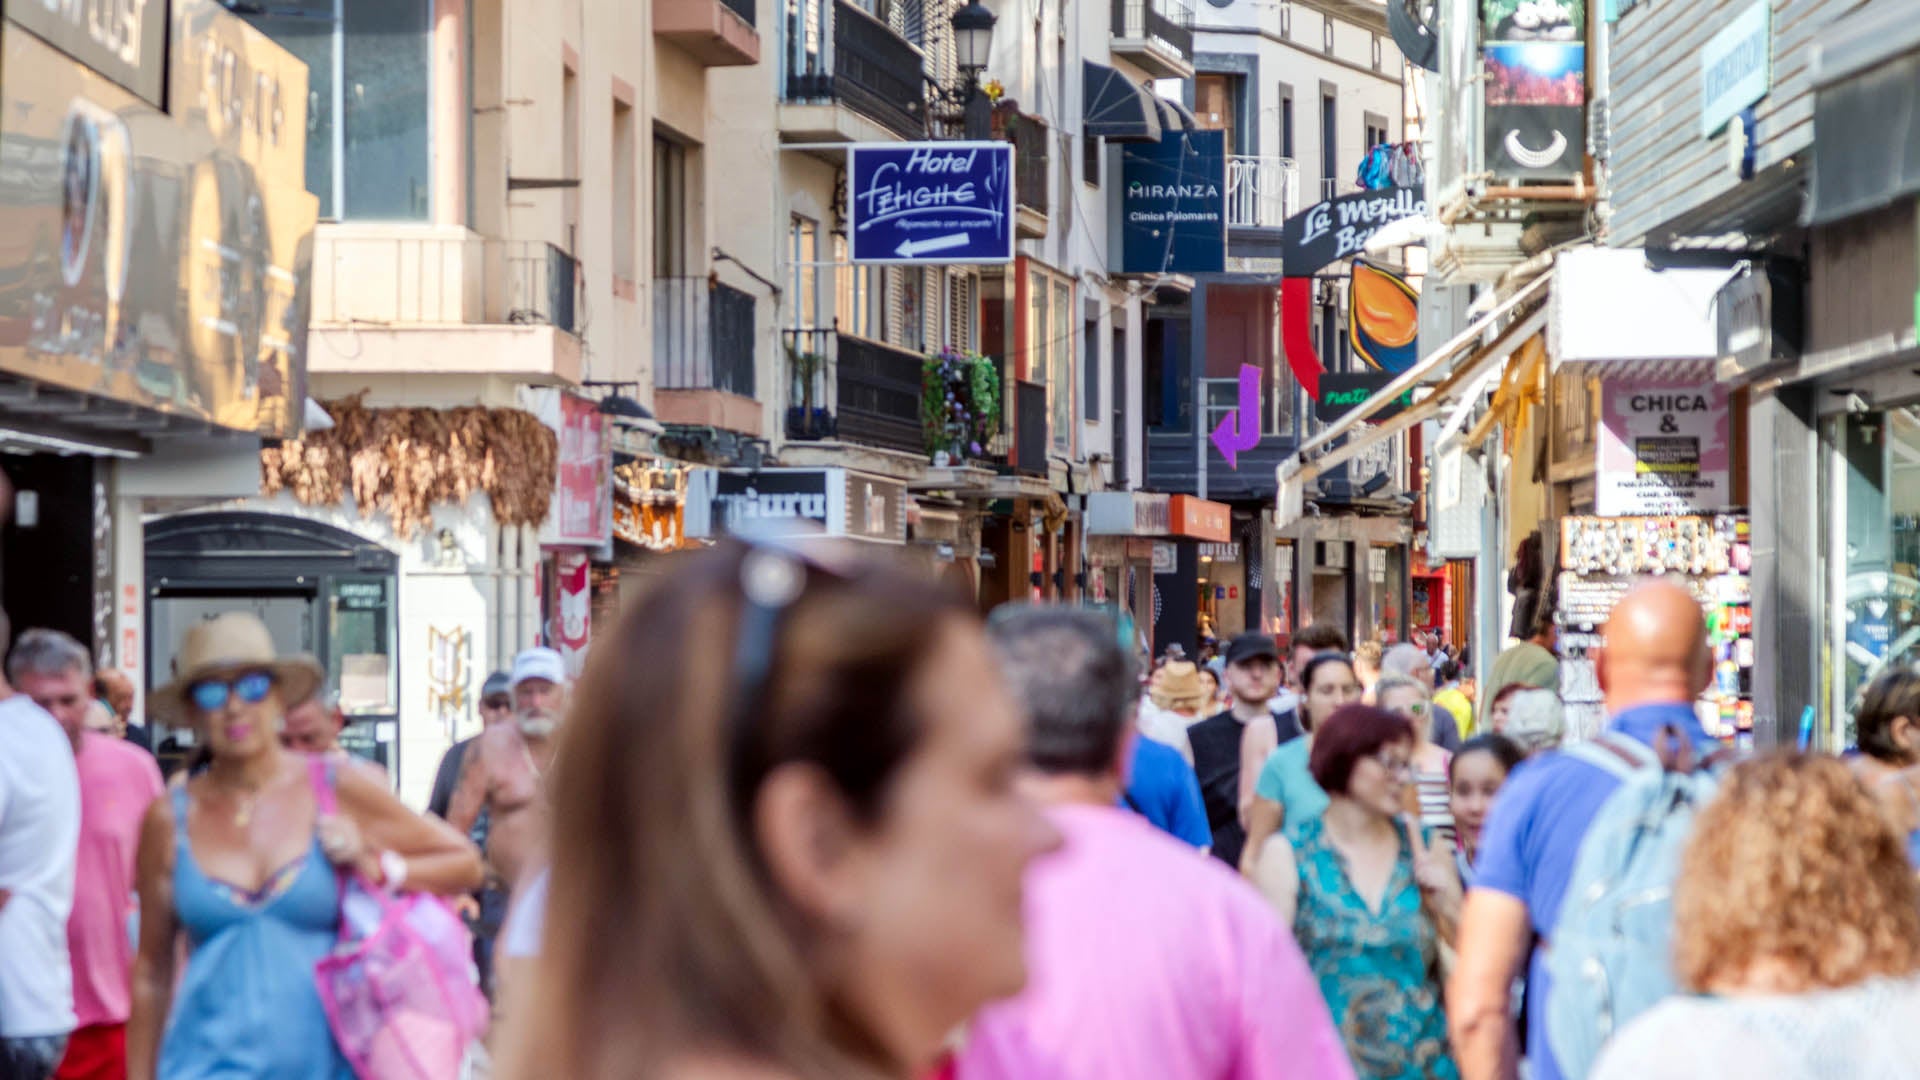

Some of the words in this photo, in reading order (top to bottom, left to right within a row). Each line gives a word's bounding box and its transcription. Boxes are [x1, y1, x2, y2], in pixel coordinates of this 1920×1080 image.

[905, 148, 978, 173] Hotel
[1129, 184, 1218, 198] MIRANZA
[1166, 211, 1218, 221] Palomares
[1300, 201, 1333, 245] La
[1631, 395, 1708, 412] CHICA
[1659, 414, 1679, 433] &
[1199, 543, 1240, 556] OUTLET
